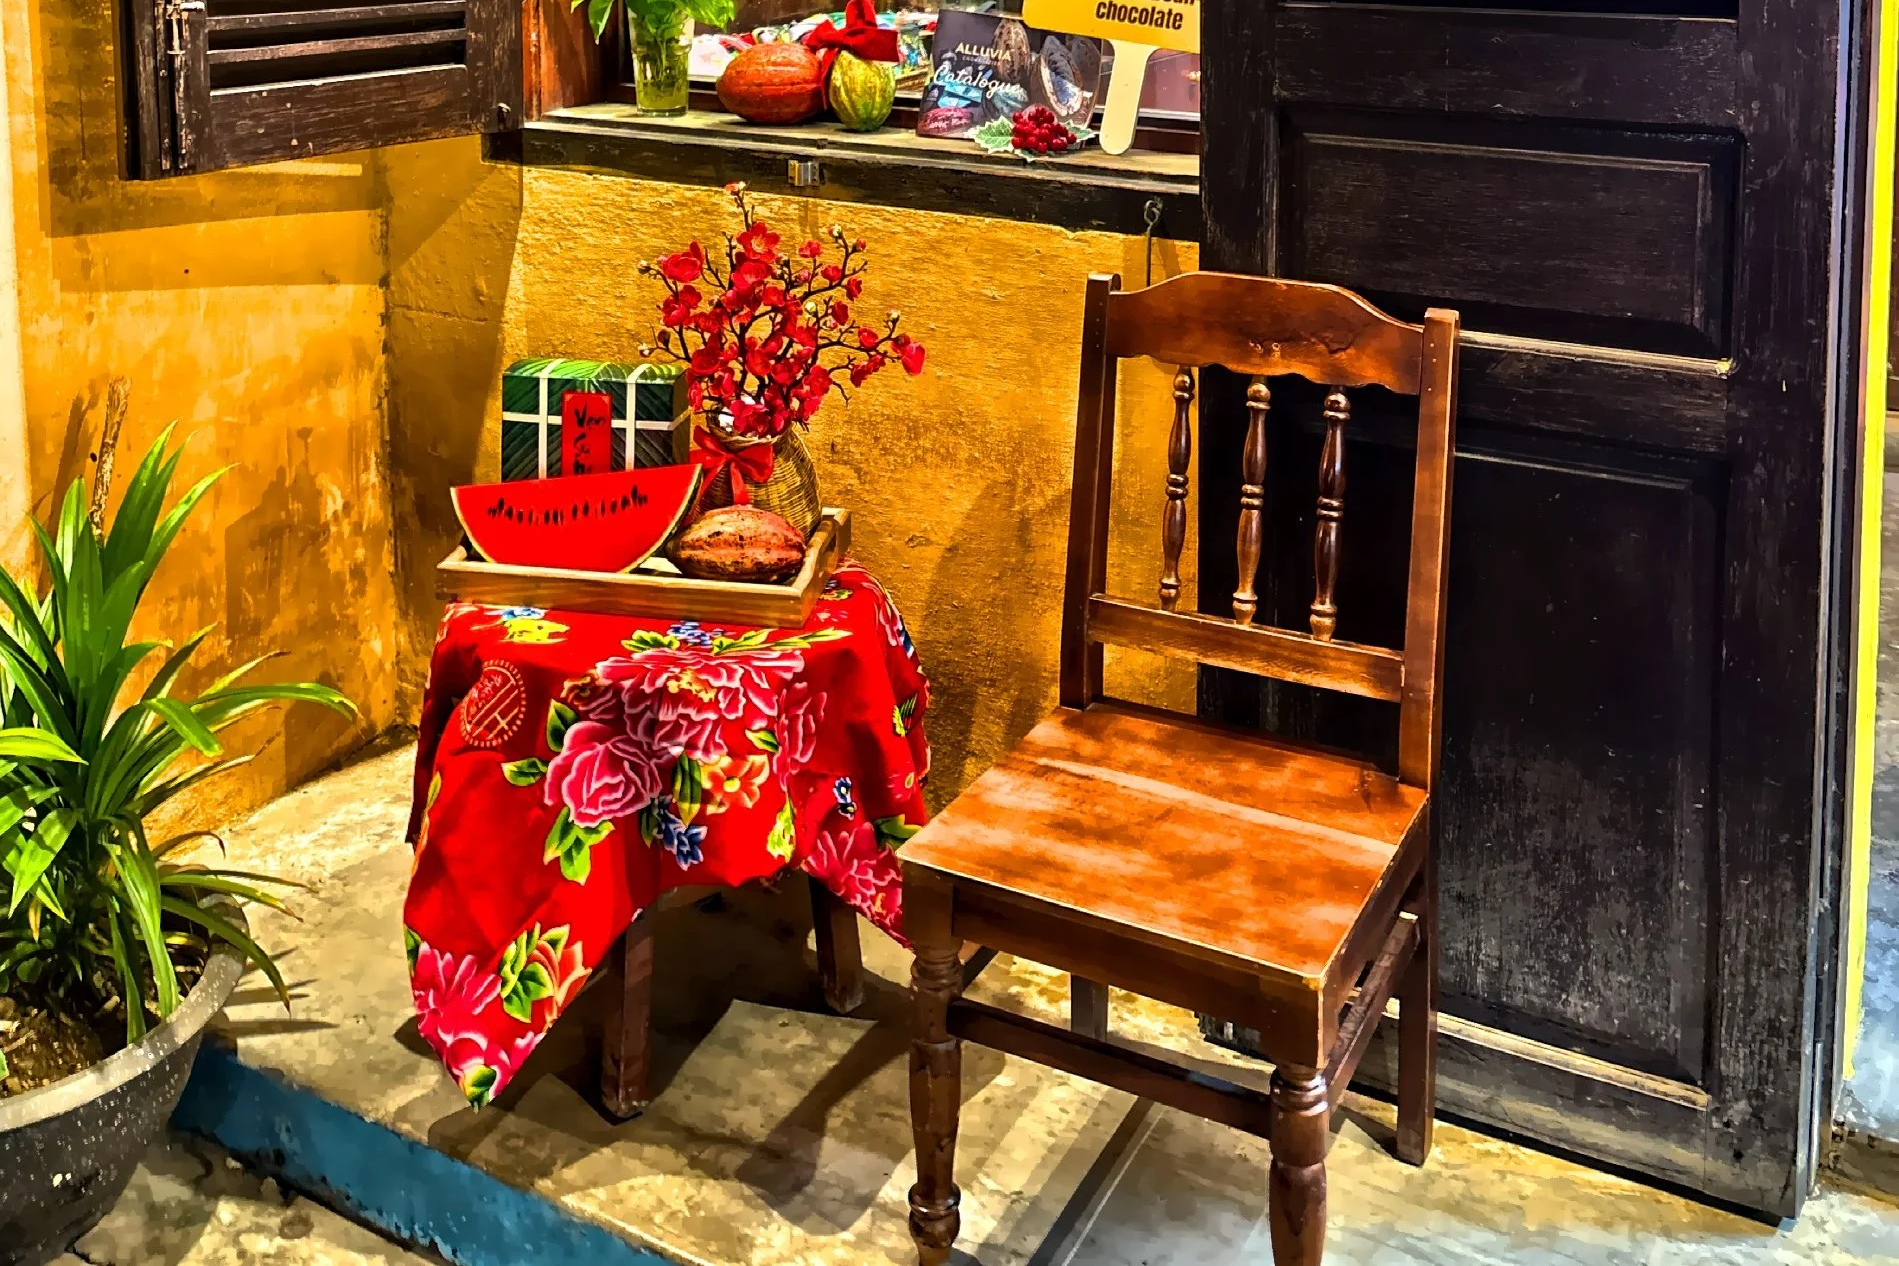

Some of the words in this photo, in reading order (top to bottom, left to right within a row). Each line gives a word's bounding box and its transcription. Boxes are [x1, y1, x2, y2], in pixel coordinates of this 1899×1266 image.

[1095, 0, 1184, 30] chocolate
[955, 42, 1011, 61] ALLUVIA
[933, 64, 1026, 99] Catalogue
